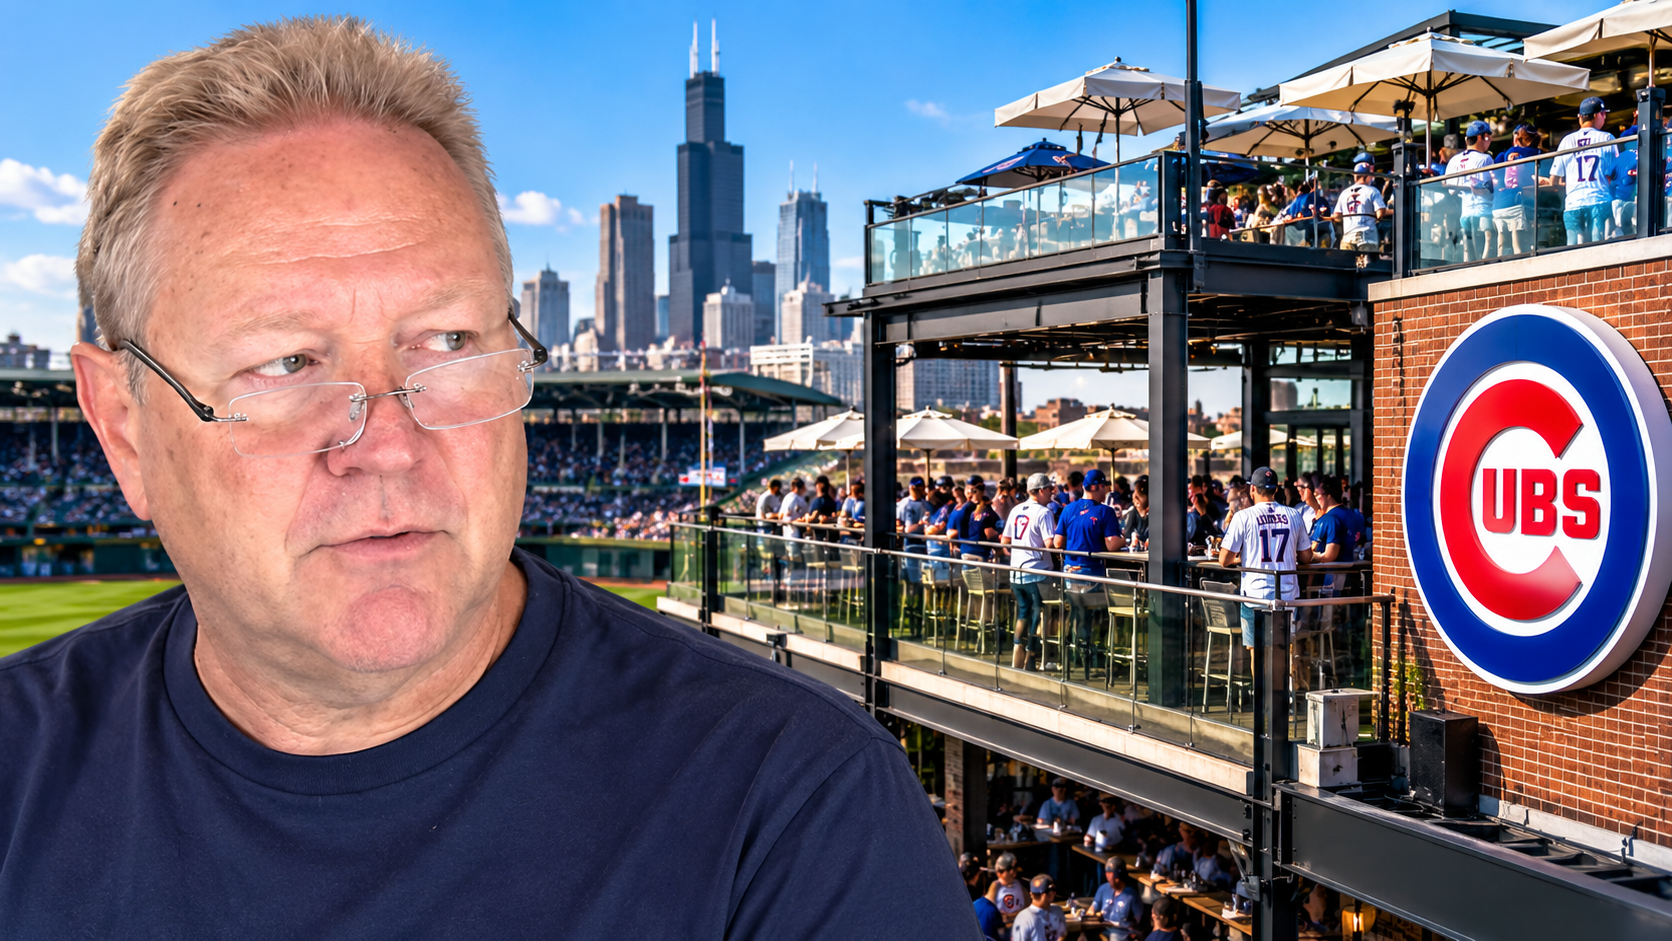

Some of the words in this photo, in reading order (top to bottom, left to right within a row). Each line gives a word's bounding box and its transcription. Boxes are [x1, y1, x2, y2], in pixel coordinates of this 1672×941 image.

[1576, 154, 1600, 182] 17
[1440, 379, 1601, 620] CUBS
[1259, 528, 1290, 563] 17
